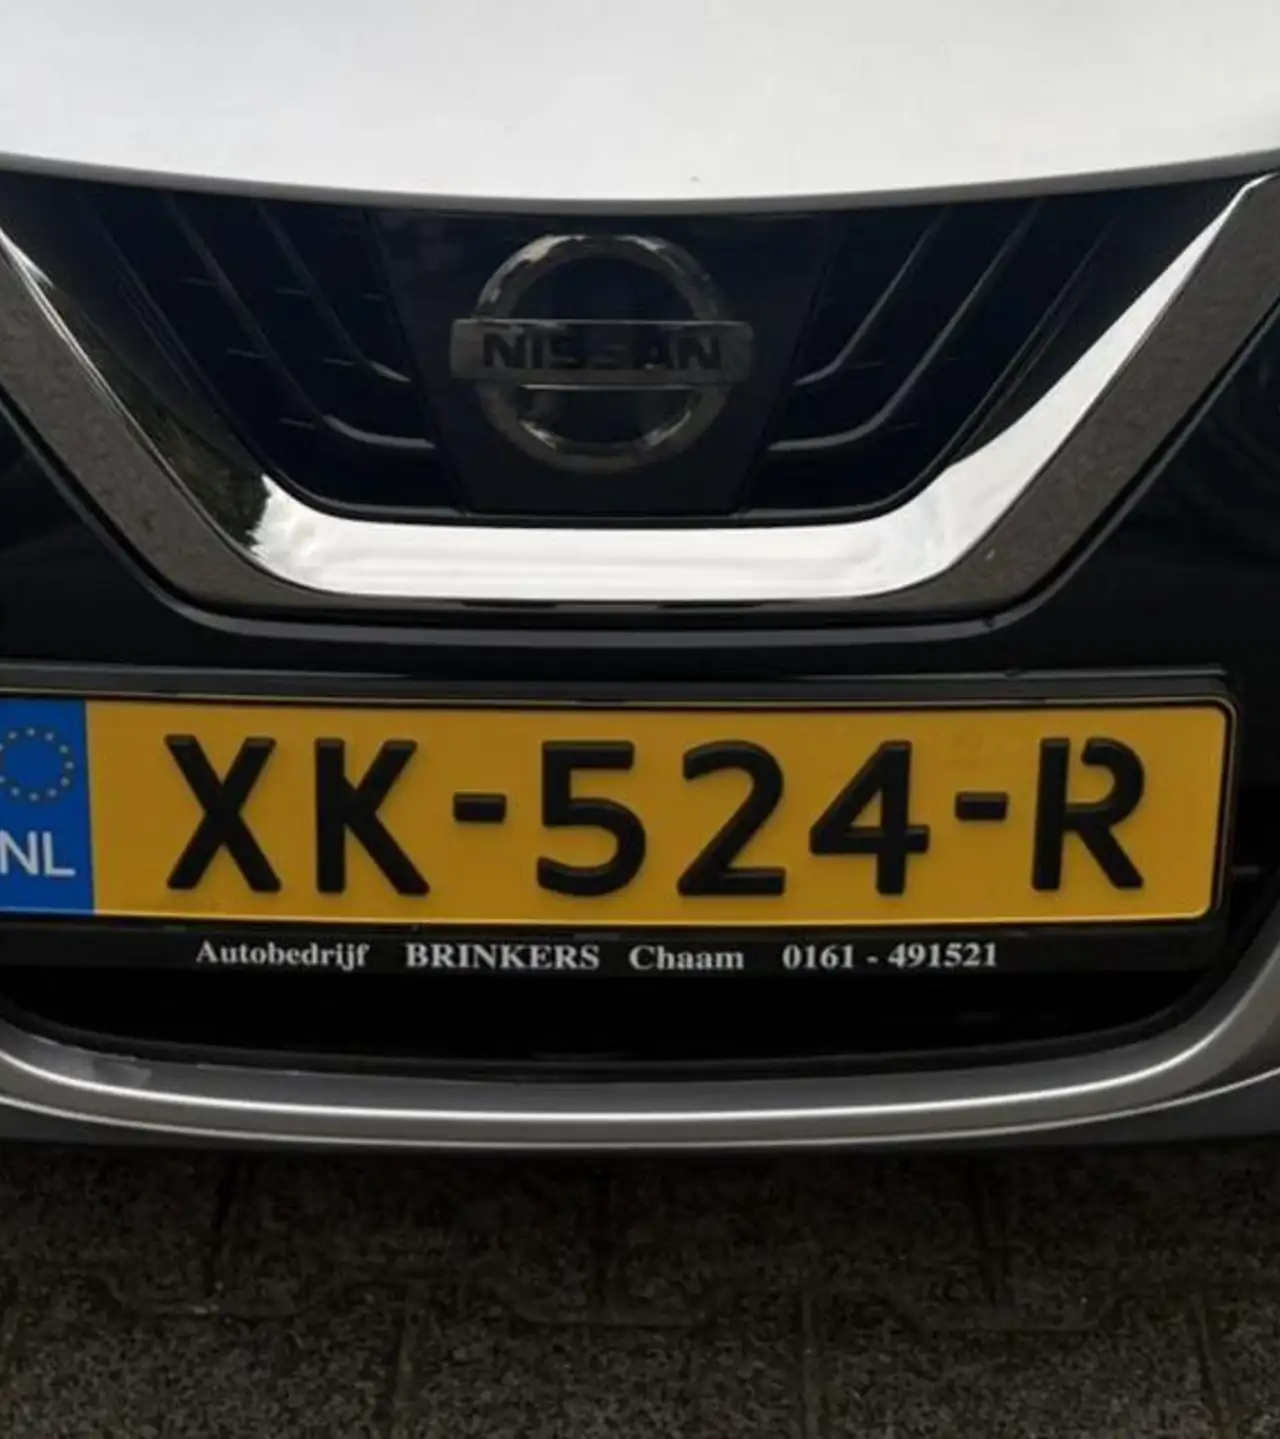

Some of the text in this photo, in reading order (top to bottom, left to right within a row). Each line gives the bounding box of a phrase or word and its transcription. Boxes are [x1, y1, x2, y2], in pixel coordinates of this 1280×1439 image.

[482, 329, 721, 370] NISSAN
[164, 734, 1146, 897] XK-524-R
[196, 940, 370, 972] Autobedrijf
[405, 943, 600, 970] BRINKERS
[628, 944, 744, 970] Chaam
[782, 944, 854, 969] 0161
[888, 942, 998, 968] 491521
